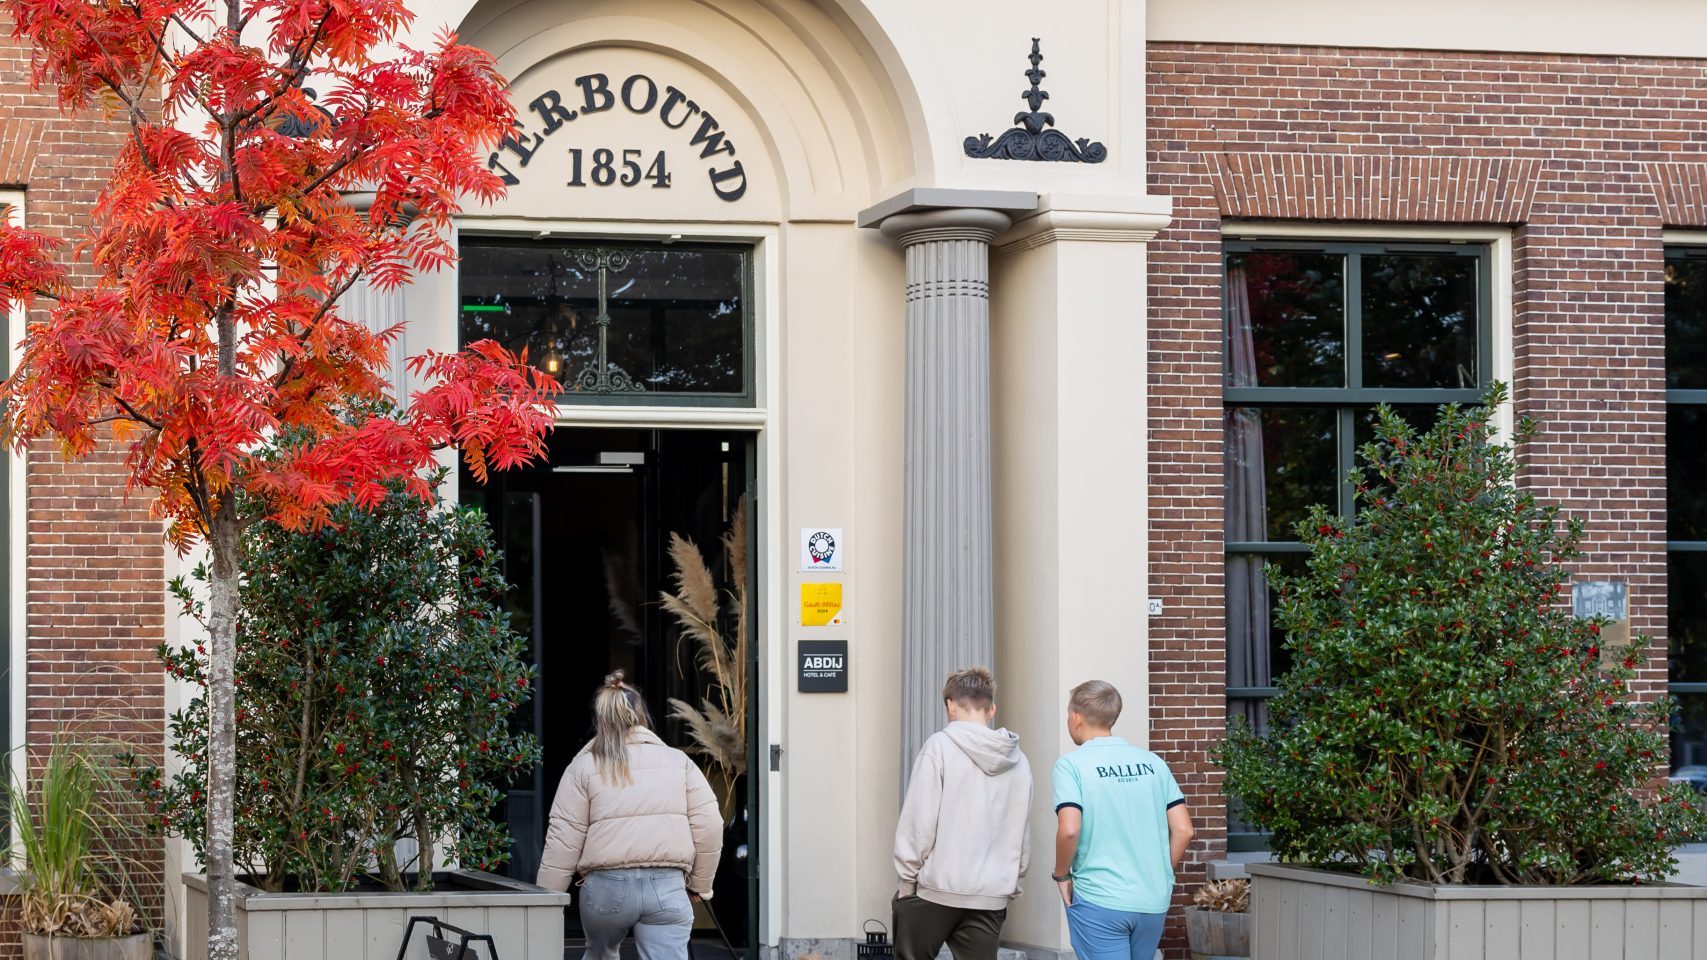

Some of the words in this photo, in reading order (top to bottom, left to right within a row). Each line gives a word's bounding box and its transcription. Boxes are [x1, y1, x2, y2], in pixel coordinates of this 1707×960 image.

[567, 148, 671, 188] 1854
[810, 532, 833, 544] DUTCH
[810, 545, 834, 559] CUISINE
[803, 657, 843, 669] ABDIJ
[1096, 763, 1155, 778] BALLIN
